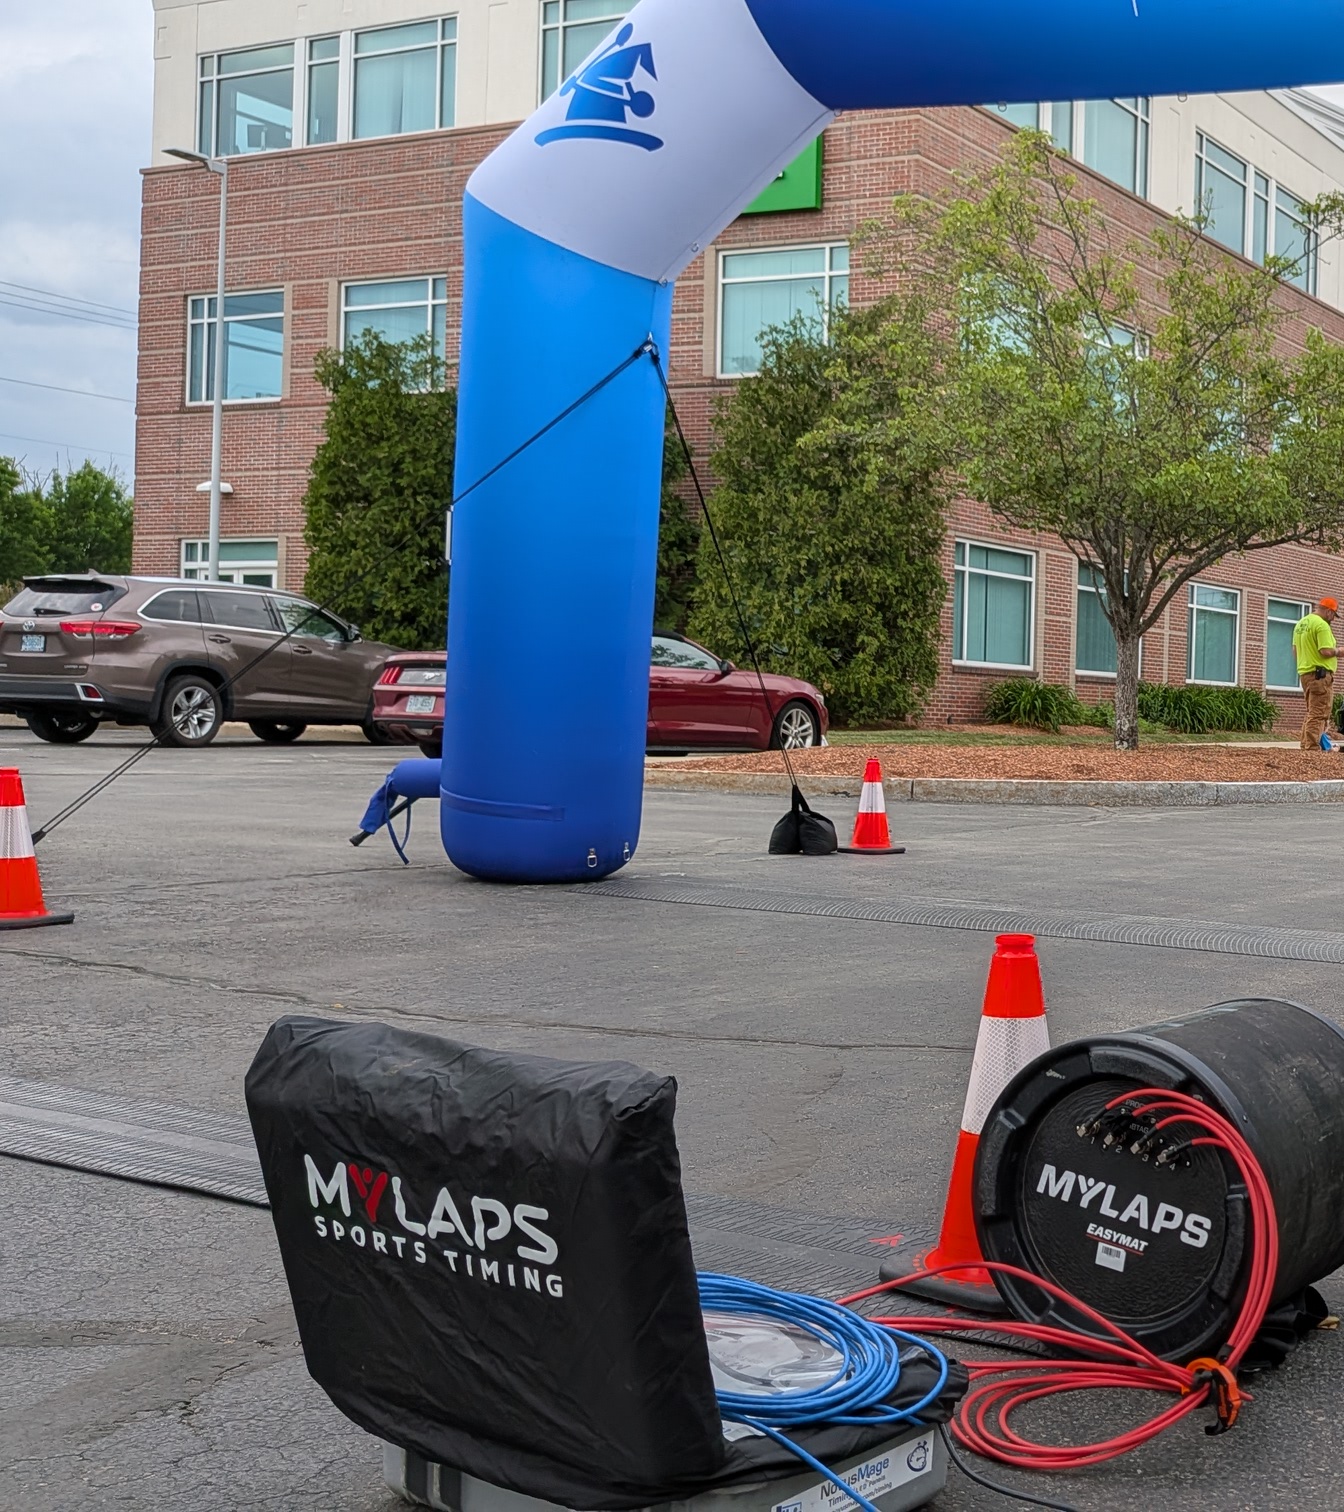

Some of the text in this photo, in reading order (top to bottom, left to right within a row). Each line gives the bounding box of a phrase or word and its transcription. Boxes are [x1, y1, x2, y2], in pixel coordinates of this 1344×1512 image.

[1115, 1145, 1123, 1154] 2
[1142, 1153, 1149, 1162] 3
[1169, 1162, 1176, 1171] 4
[304, 1153, 559, 1265] MYLAPS
[1036, 1163, 1212, 1249] MYLAPS
[1086, 1223, 1149, 1252] EASYMAT
[314, 1216, 564, 1298] SPORTS TIMING
